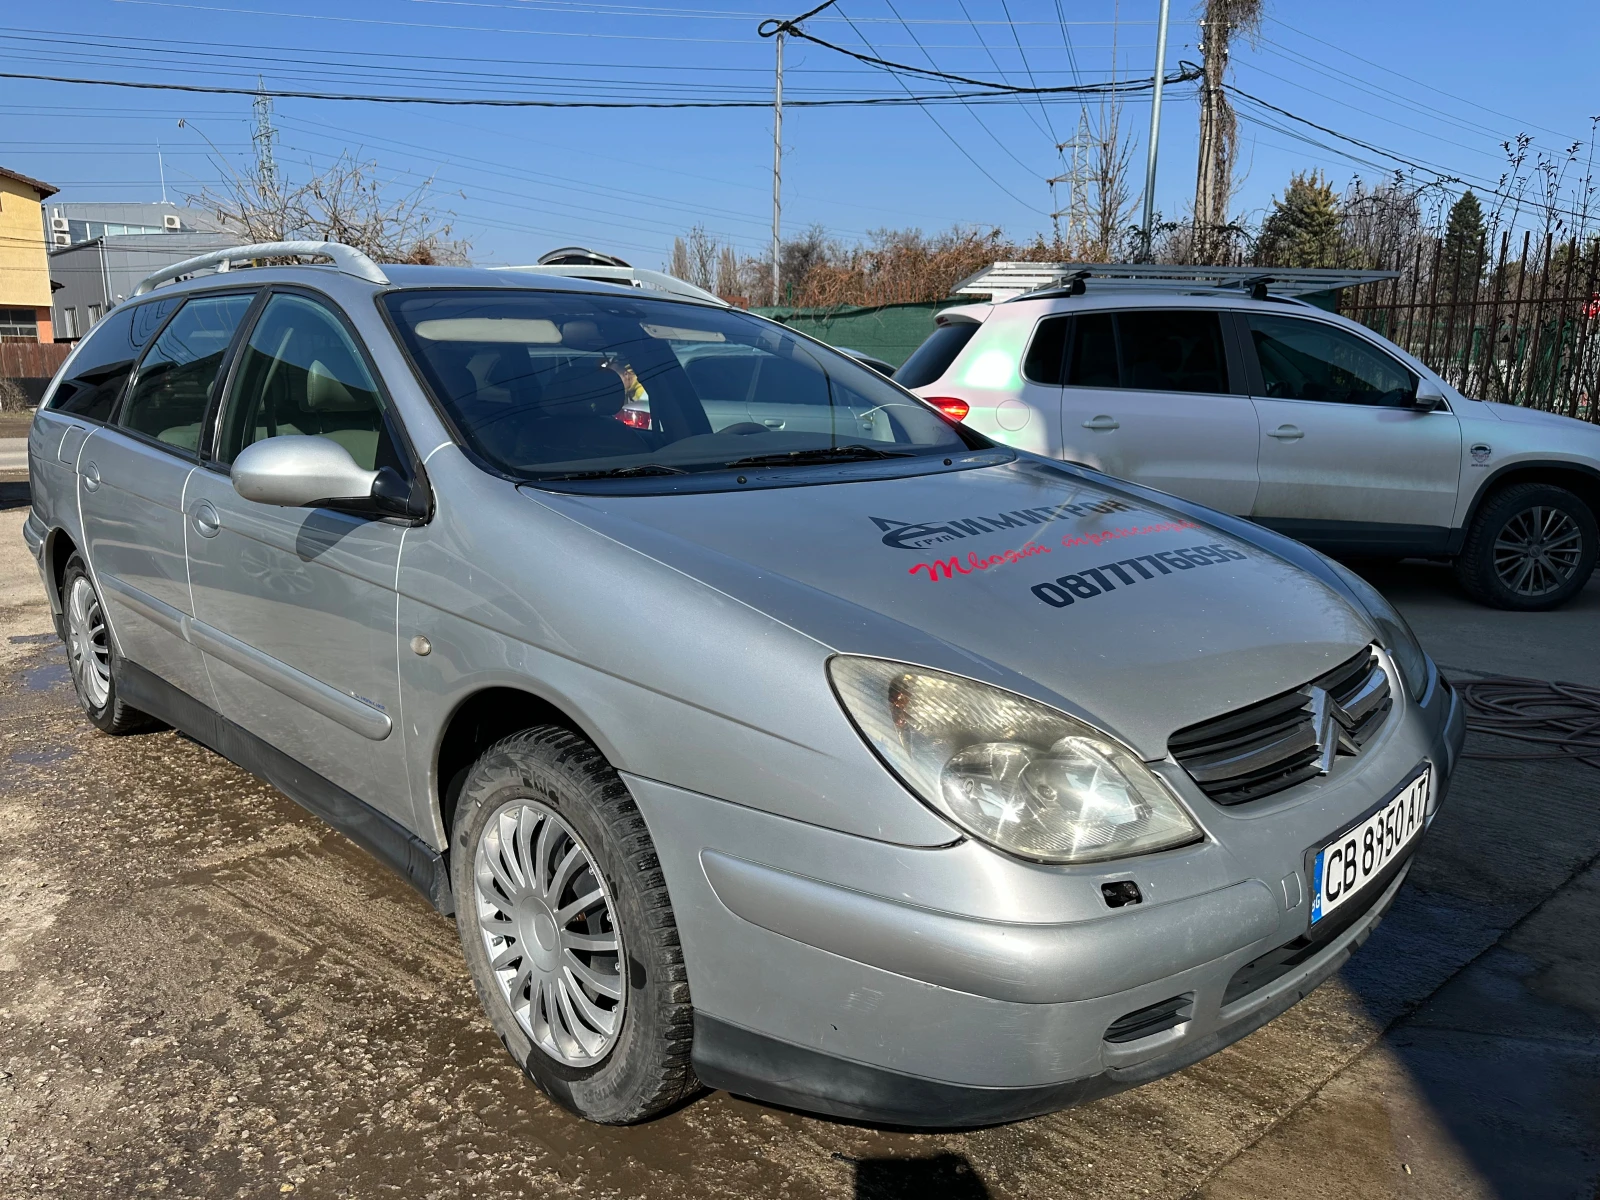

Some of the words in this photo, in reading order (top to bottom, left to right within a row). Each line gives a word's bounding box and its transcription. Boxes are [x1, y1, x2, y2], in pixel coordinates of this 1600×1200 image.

[1030, 543, 1248, 609] 0877776696
[1362, 801, 1403, 876] 8950
[1406, 777, 1426, 836] AT
